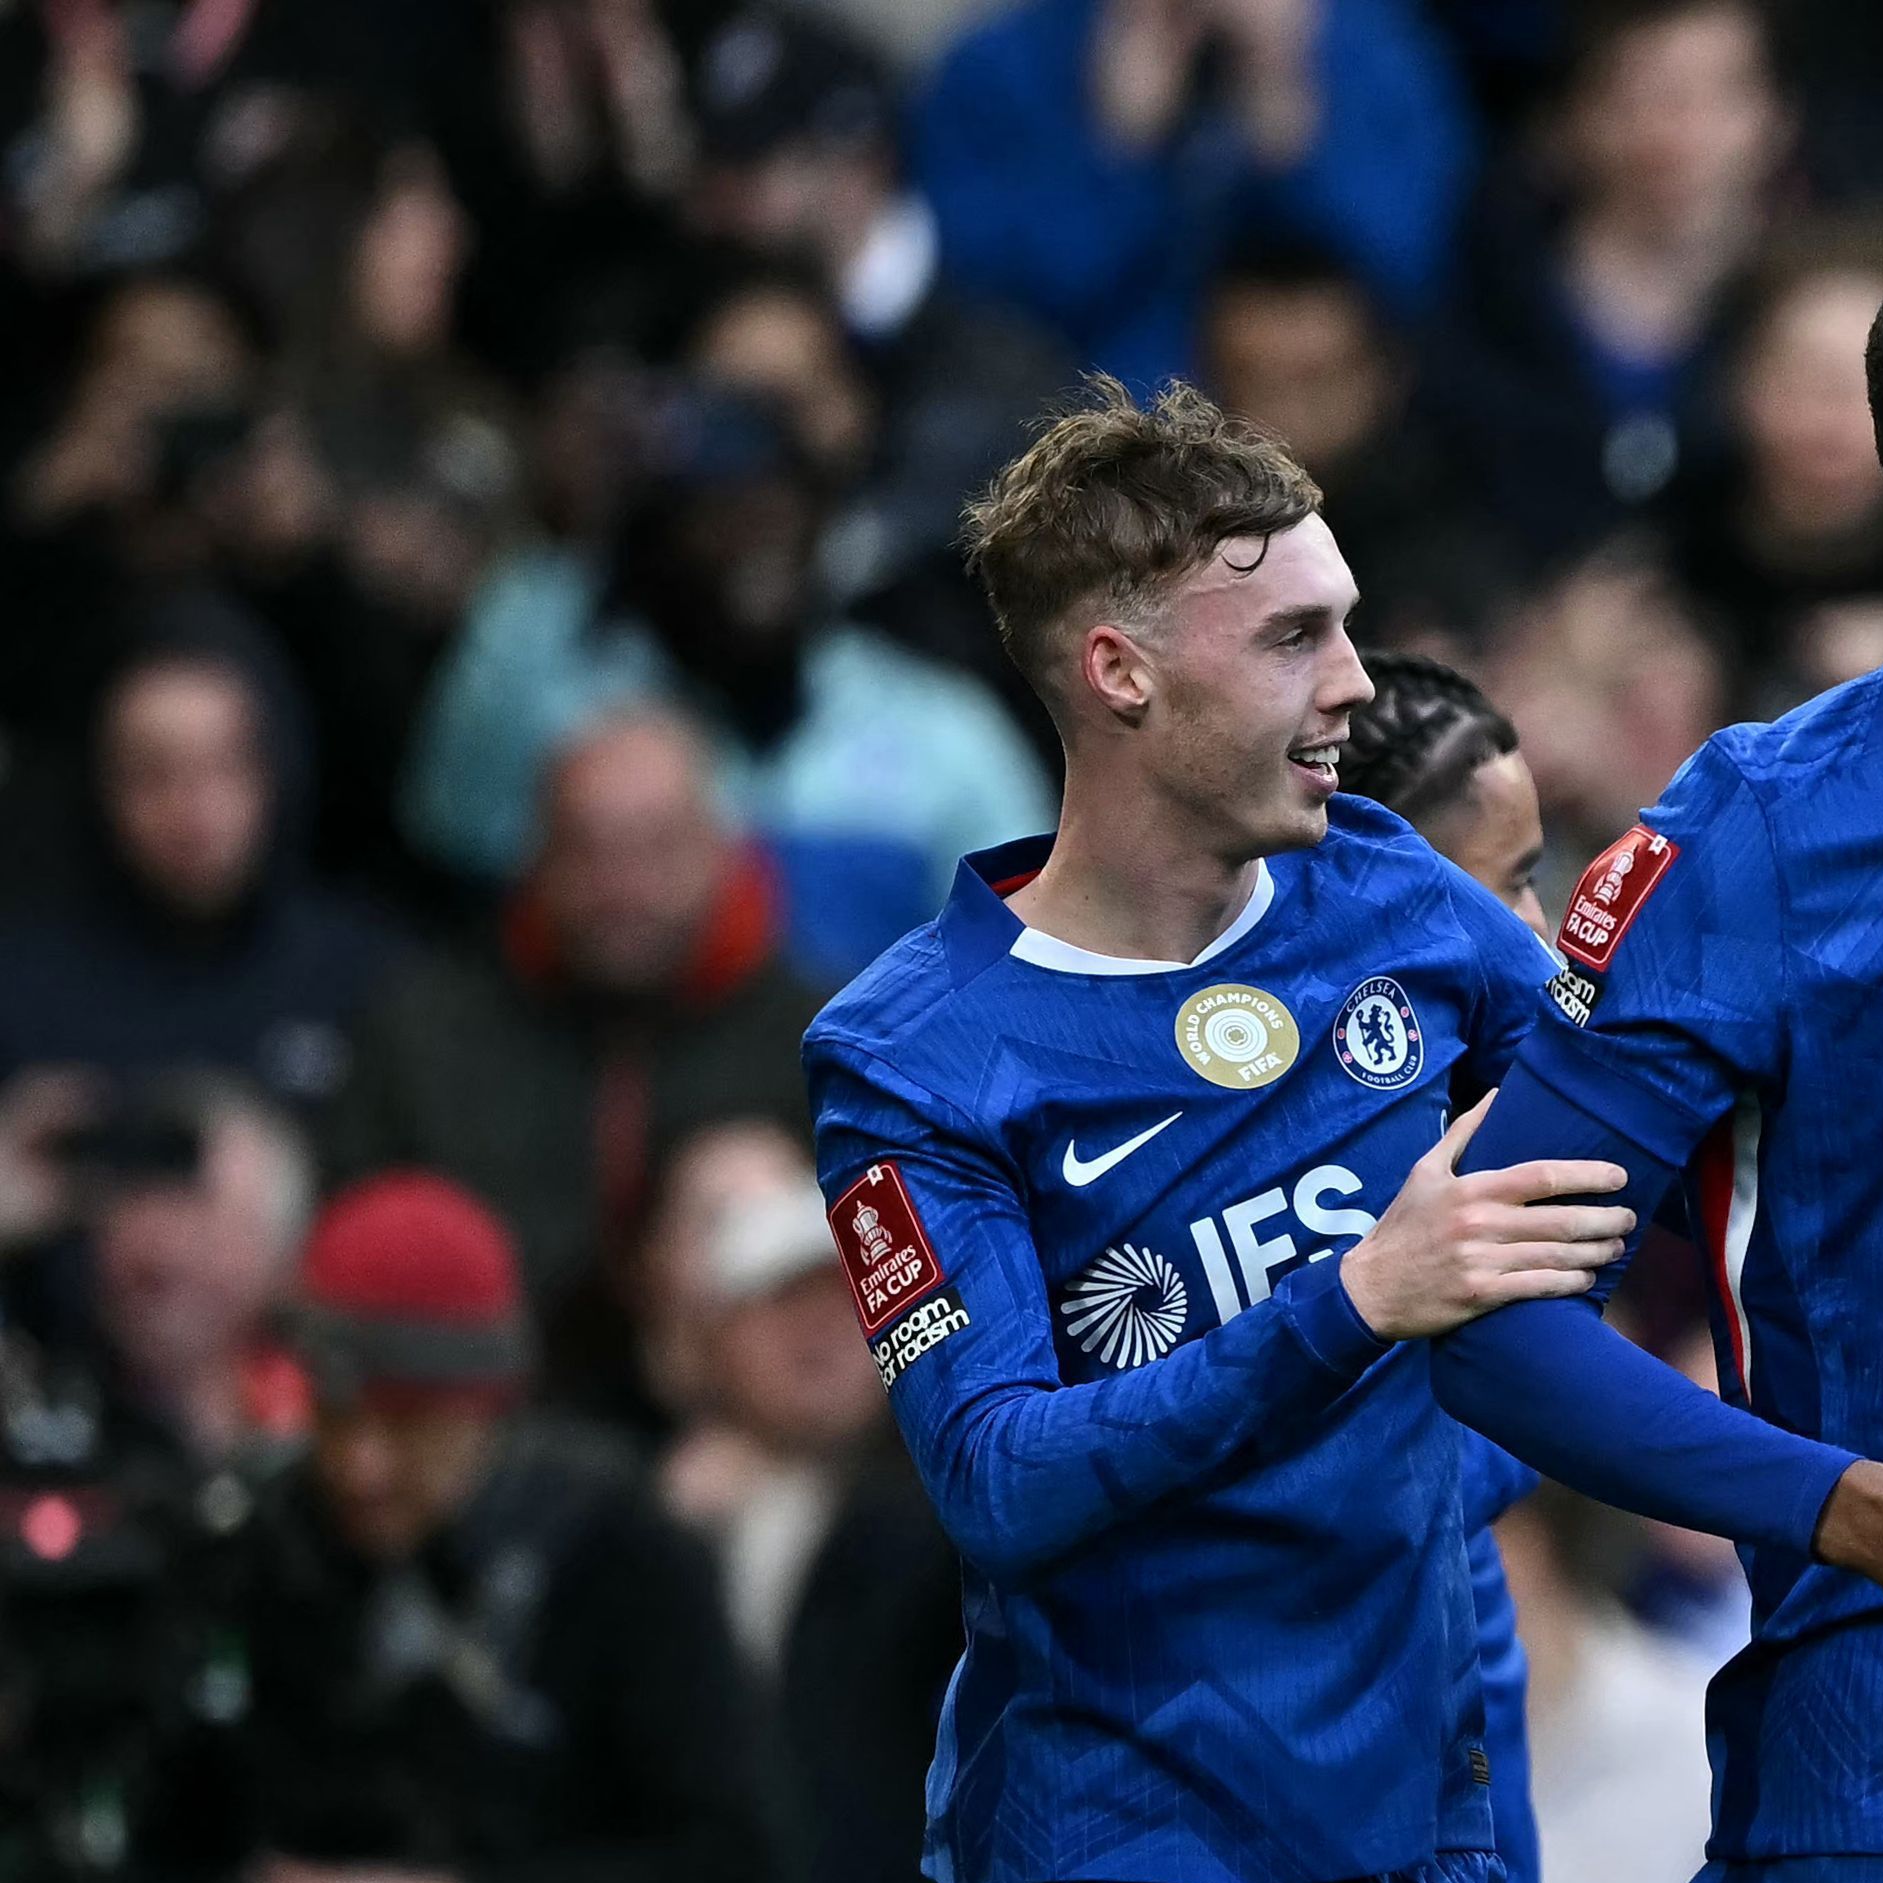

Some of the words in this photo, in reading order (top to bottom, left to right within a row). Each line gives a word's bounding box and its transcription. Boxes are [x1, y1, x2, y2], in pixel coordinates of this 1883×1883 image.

[1566, 913, 1581, 936] FA
[1578, 921, 1609, 947] CUP
[1574, 894, 1618, 931] Emirates
[1346, 980, 1395, 1013] CHELSEA
[1558, 968, 1596, 1004] oom
[1196, 992, 1283, 1030] CHAMPIONS
[1185, 1014, 1211, 1066] WORLD
[1237, 1052, 1283, 1082] FIFA
[859, 1244, 917, 1296] Emirates
[866, 1290, 888, 1314] FA
[886, 1258, 923, 1296] CUP
[891, 1297, 950, 1345] room
[896, 1308, 971, 1371] racism
